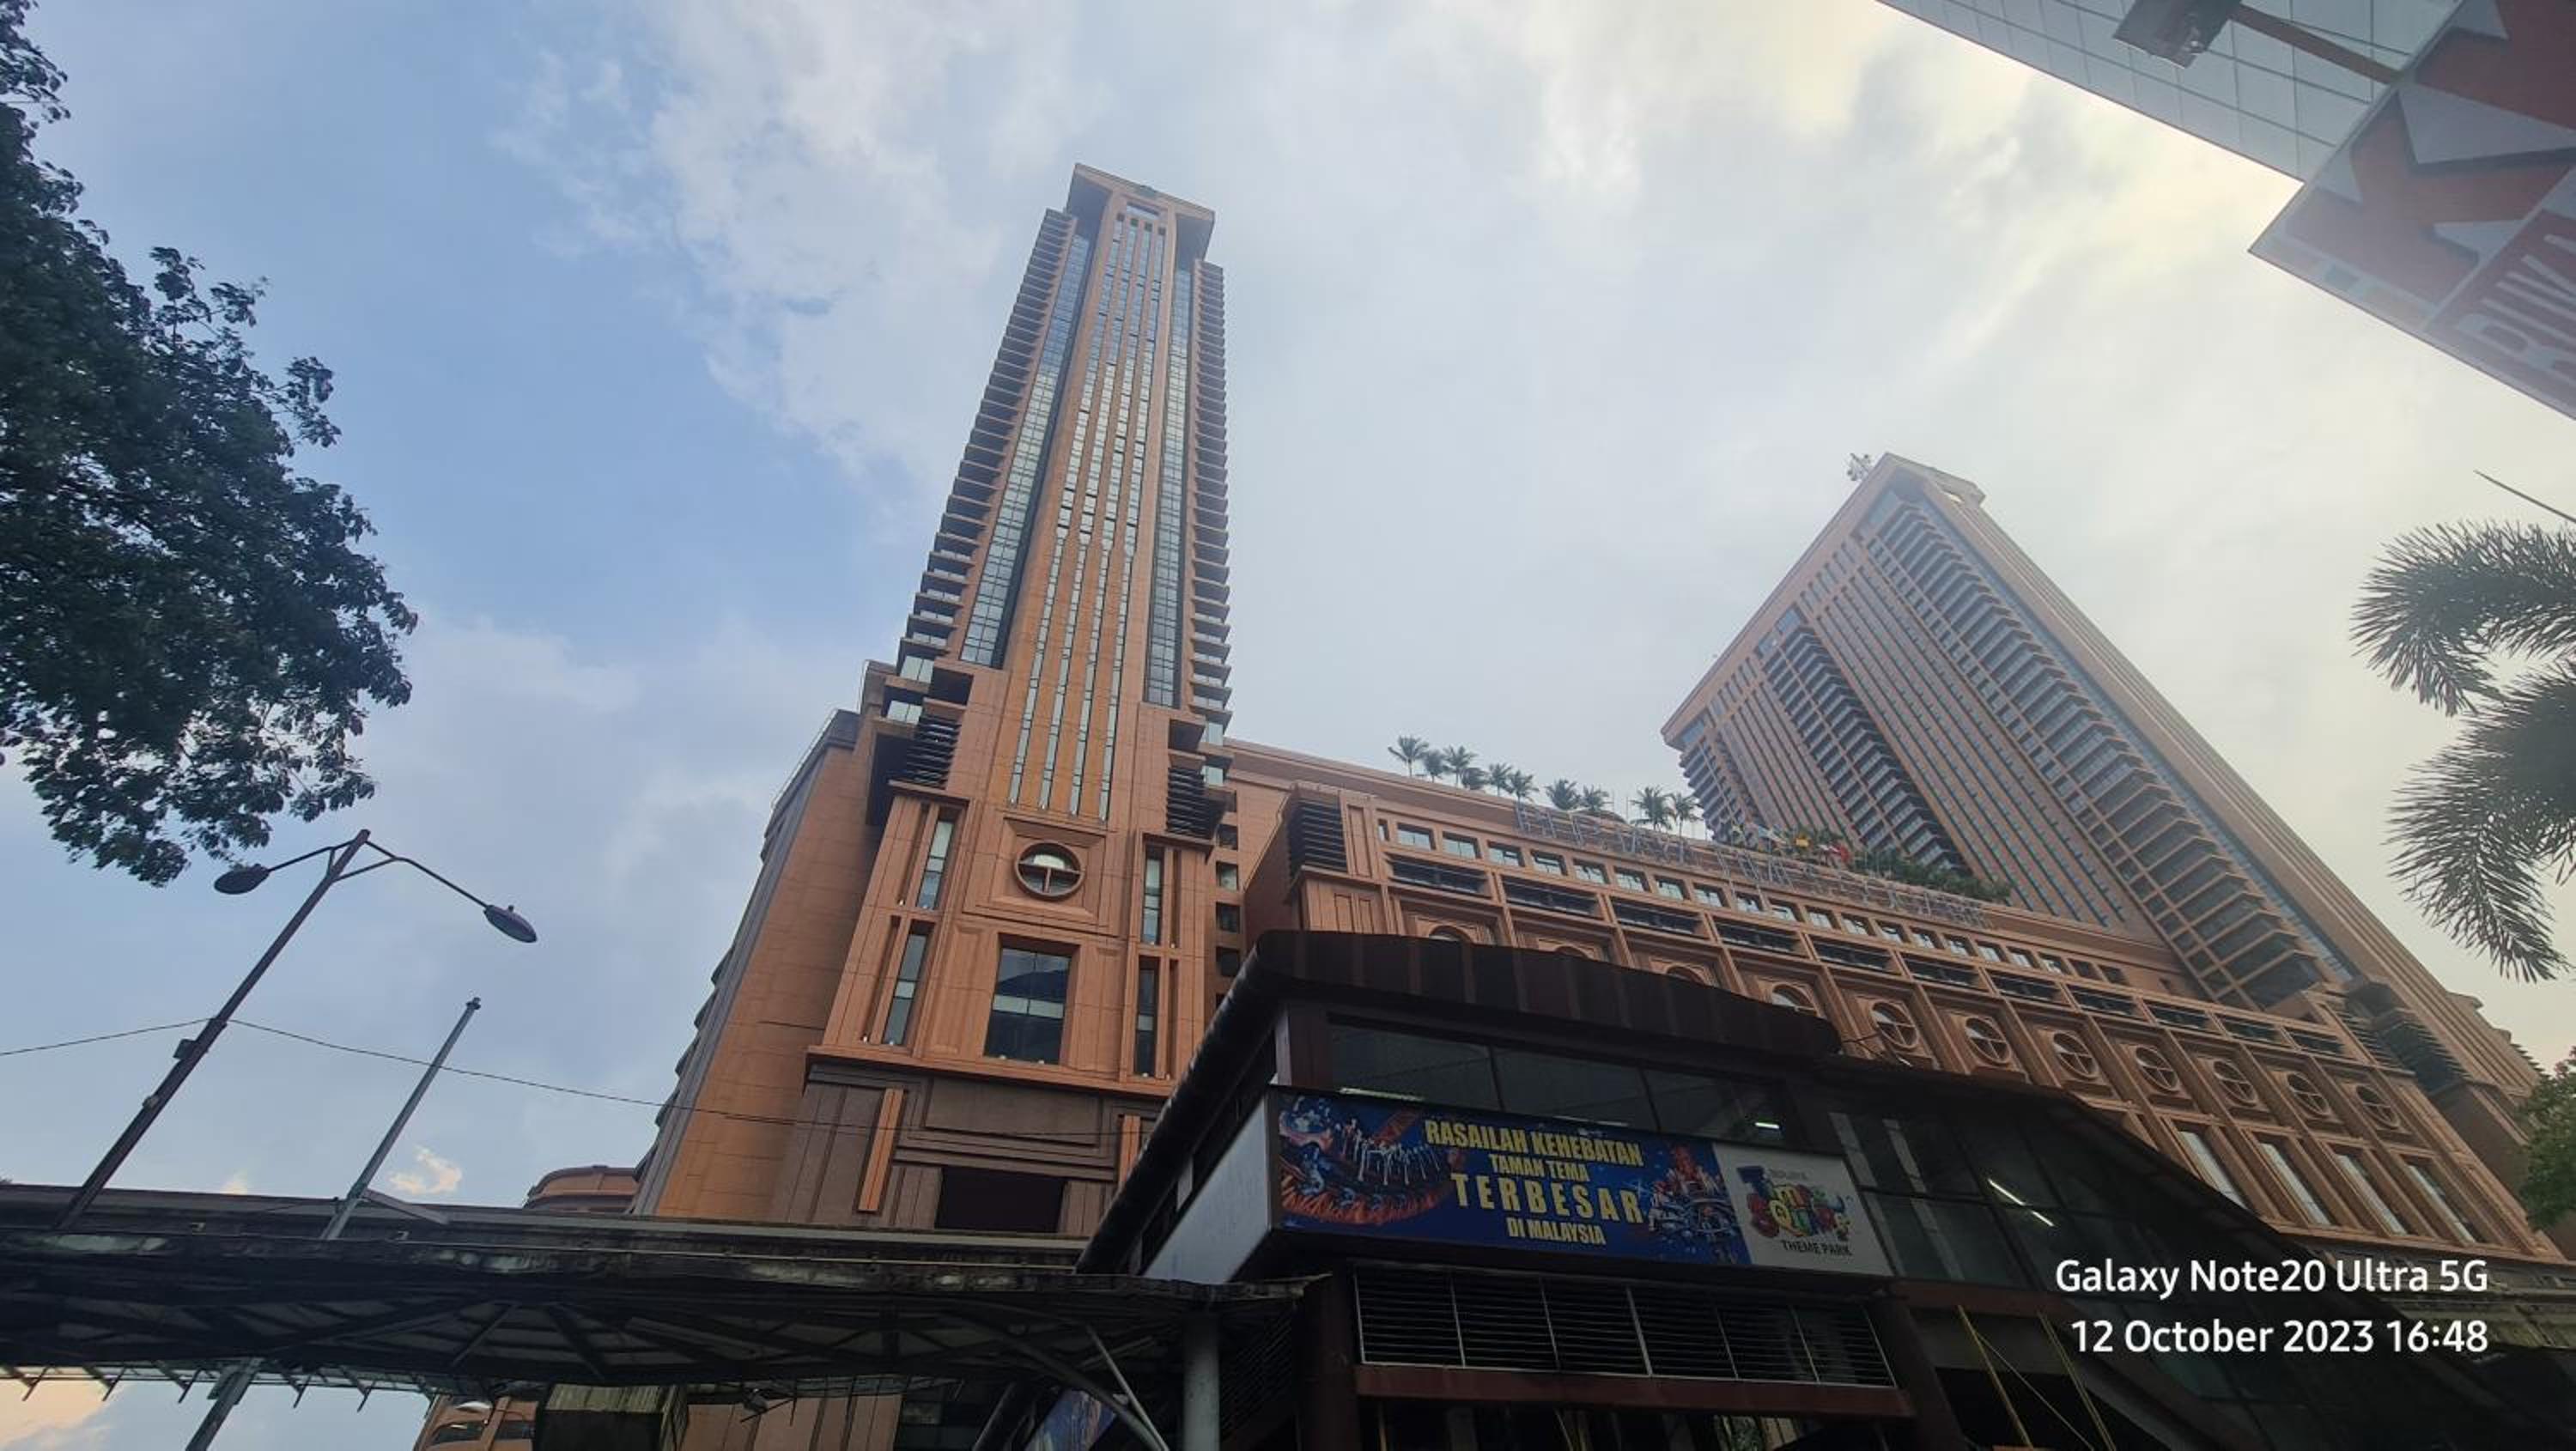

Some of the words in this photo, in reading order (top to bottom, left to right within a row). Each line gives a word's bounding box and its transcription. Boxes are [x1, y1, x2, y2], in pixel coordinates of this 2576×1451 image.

[1425, 1120, 1528, 1153] RASAILAH
[1530, 1132, 1644, 1166] KEHEBATAN
[1489, 1153, 1546, 1177] TAMAN
[1546, 1160, 1590, 1182] TEMA
[1450, 1173, 1643, 1223] TERBESAR
[1506, 1217, 1526, 1238] DI
[1527, 1219, 1607, 1246] MALAYSIA
[1782, 1241, 1820, 1254] THEME
[1821, 1243, 1853, 1257] PARK
